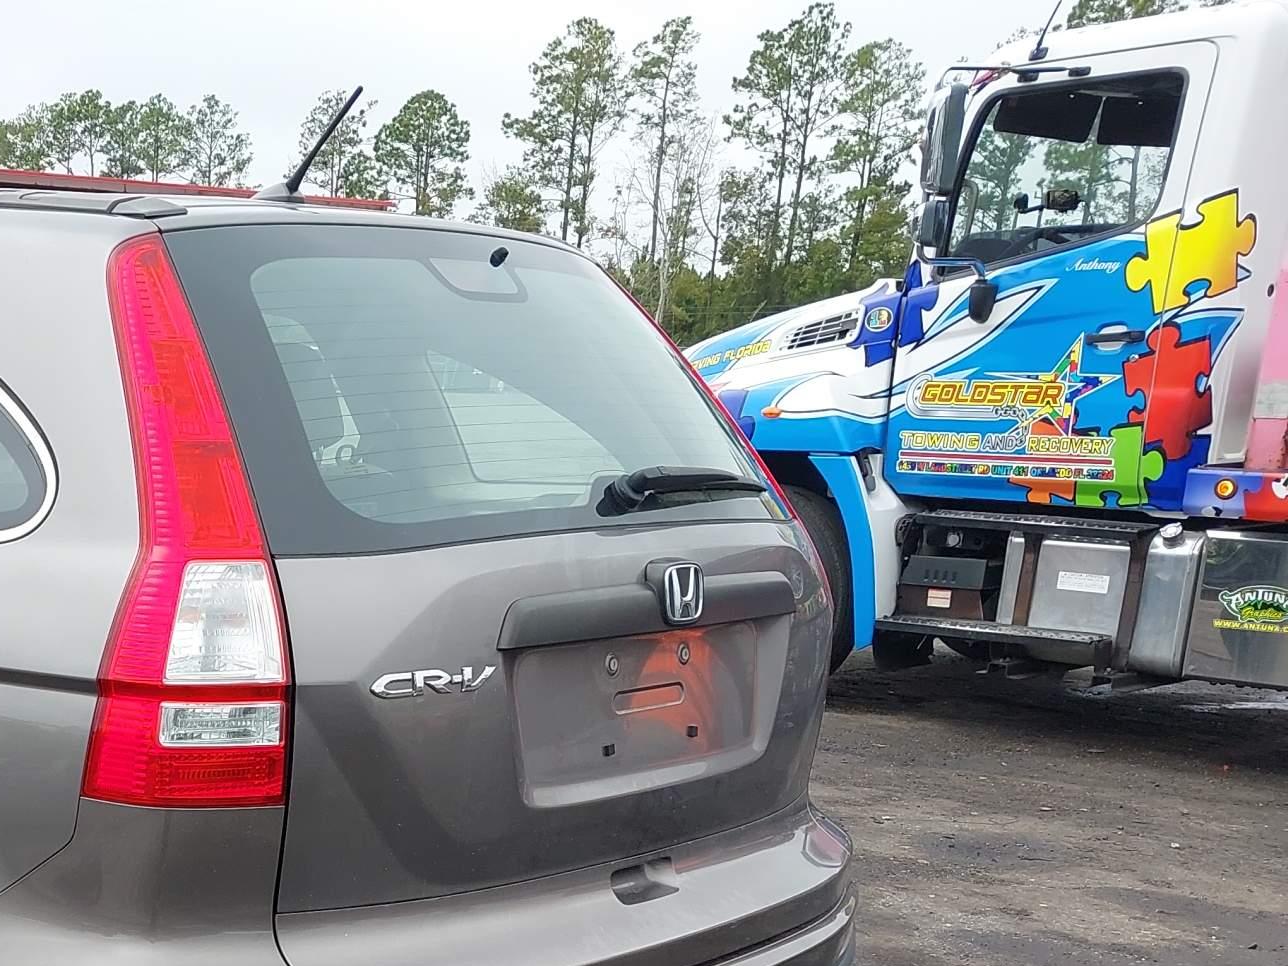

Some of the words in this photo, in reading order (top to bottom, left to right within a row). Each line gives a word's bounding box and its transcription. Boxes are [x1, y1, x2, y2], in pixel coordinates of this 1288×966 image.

[1065, 257, 1121, 274] Anthony
[900, 432, 981, 450] TOWING
[982, 434, 1018, 450] AND
[1026, 437, 1114, 456] RECOVERY
[991, 464, 1012, 475] UNIT
[369, 665, 497, 699] CR-V
